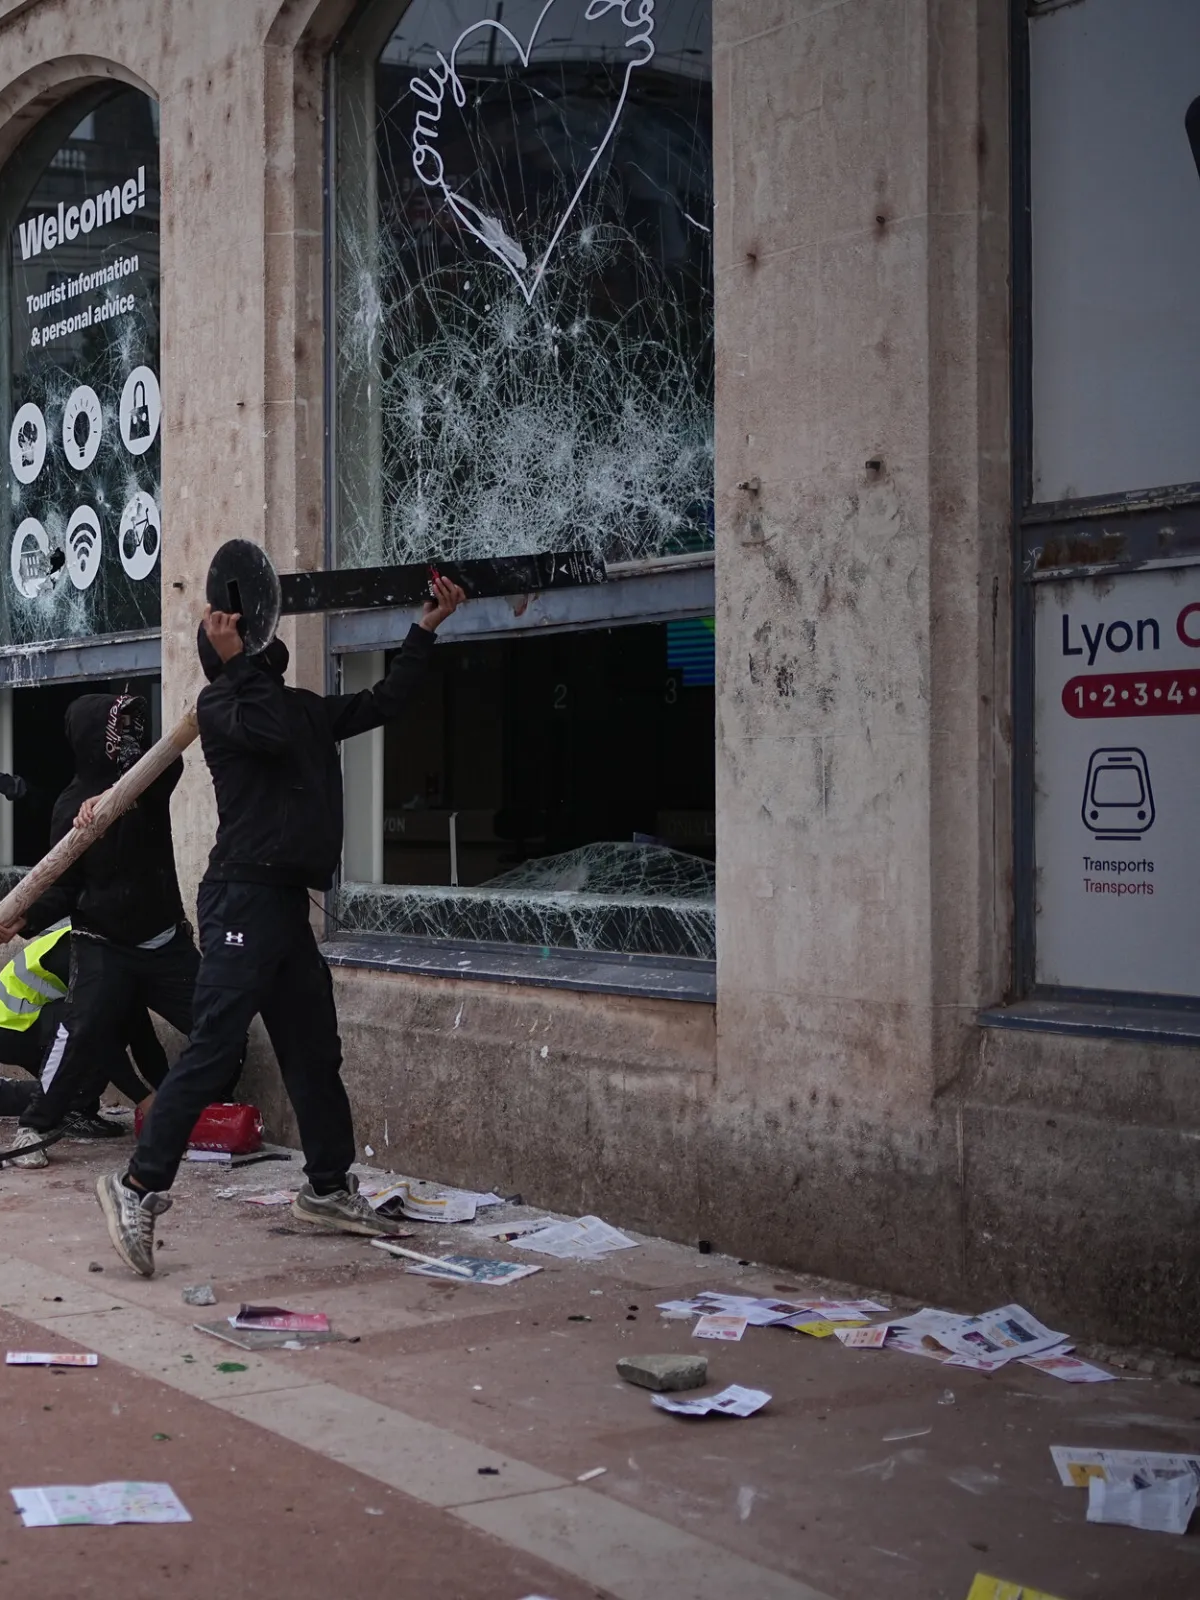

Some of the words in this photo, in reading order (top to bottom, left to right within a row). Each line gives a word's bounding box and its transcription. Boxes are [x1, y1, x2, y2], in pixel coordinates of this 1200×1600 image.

[410, 51, 466, 185] only
[18, 165, 146, 261] Welcome!
[26, 281, 66, 314] Tourist
[67, 254, 139, 299] information
[30, 326, 41, 347] &
[42, 304, 92, 348] personal
[94, 293, 135, 322] advice
[1061, 613, 1160, 666] Lyon
[1083, 856, 1155, 875] Transports
[1083, 878, 1154, 896] Transports
